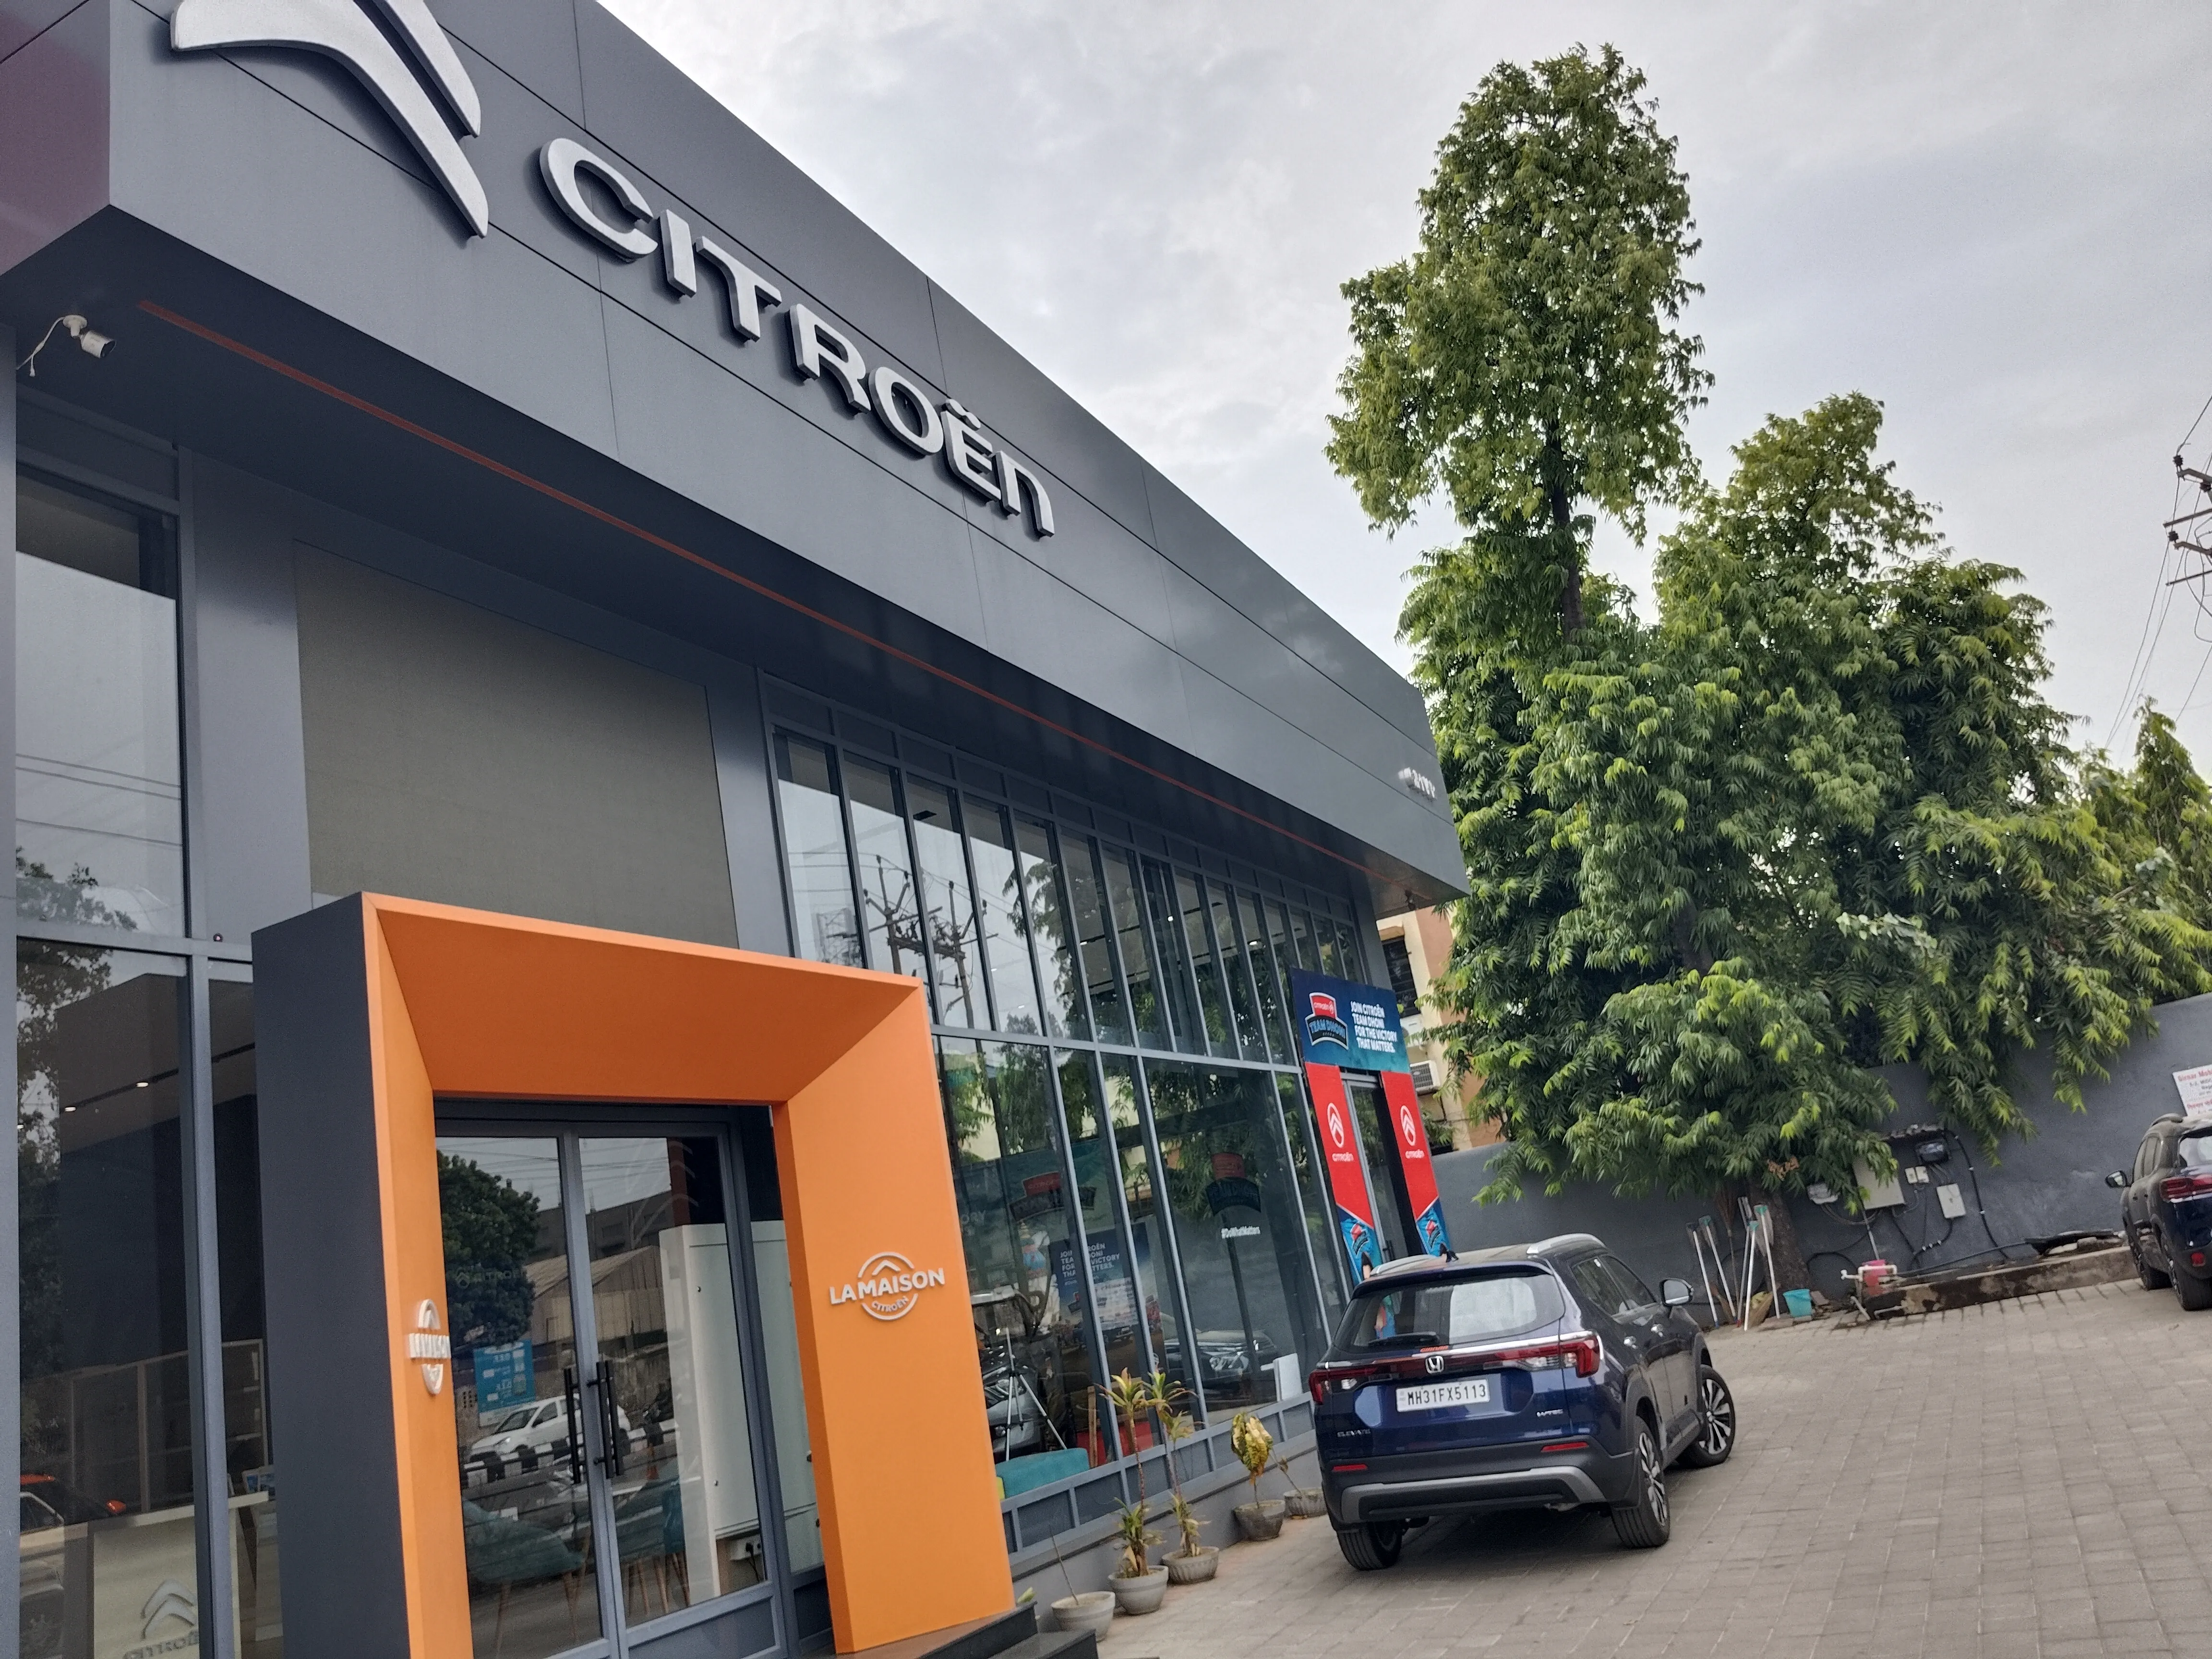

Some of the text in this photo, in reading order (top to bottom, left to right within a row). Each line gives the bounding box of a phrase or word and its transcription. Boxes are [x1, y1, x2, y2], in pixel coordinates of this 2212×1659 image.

[540, 137, 1055, 539] CITROËN
[1350, 1001, 1363, 1014] JOIN
[1309, 1019, 1346, 1039] TEAM DHONI
[1352, 1013, 1385, 1029] TEAM DHONI
[1355, 1025, 1397, 1042] FOR THE VICTORY
[1357, 1037, 1370, 1050] THAT
[857, 1268, 946, 1299] MAISON
[1407, 1384, 1486, 1406] MH31FX5113
